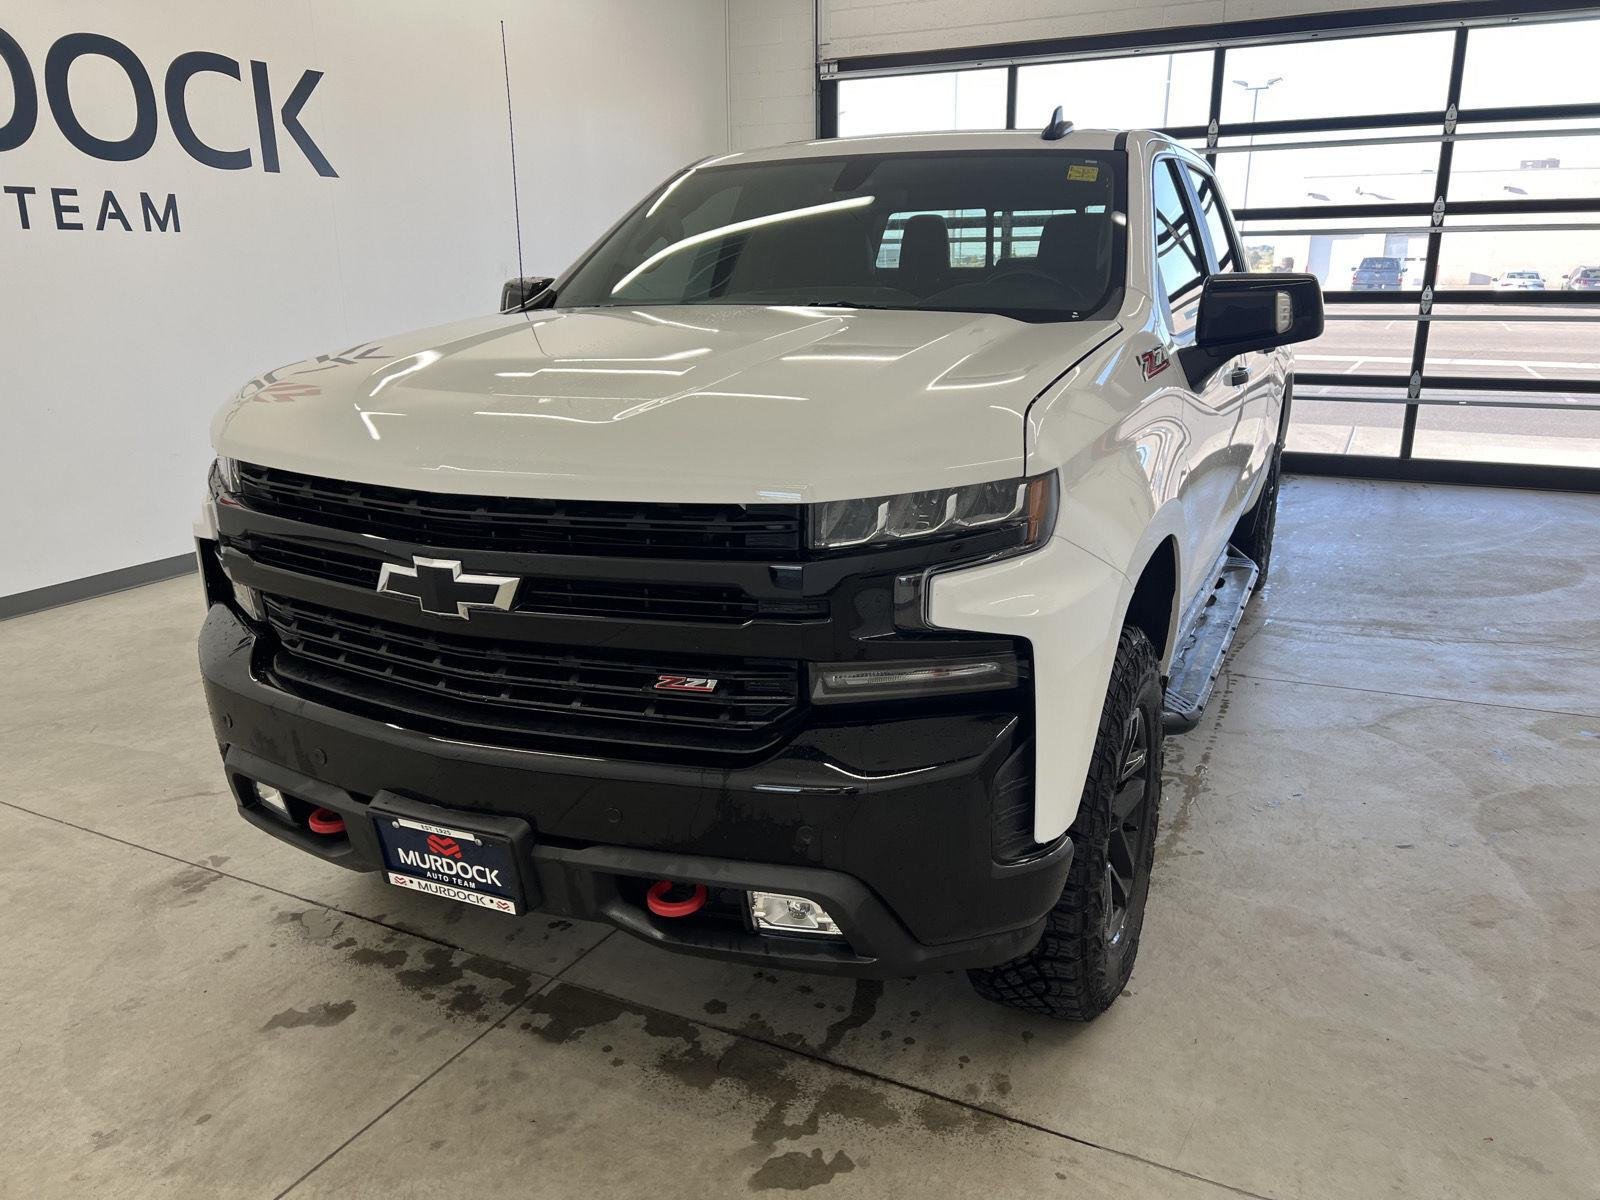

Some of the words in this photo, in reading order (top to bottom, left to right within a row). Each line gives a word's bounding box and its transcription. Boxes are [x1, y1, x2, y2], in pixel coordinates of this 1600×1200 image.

[3, 185, 181, 233] TEAM
[655, 675, 718, 692] Z71
[398, 847, 502, 887] MURDOCK
[426, 871, 449, 882] AUTO
[452, 877, 476, 889] TEAM
[417, 881, 486, 906] MURDOCK
